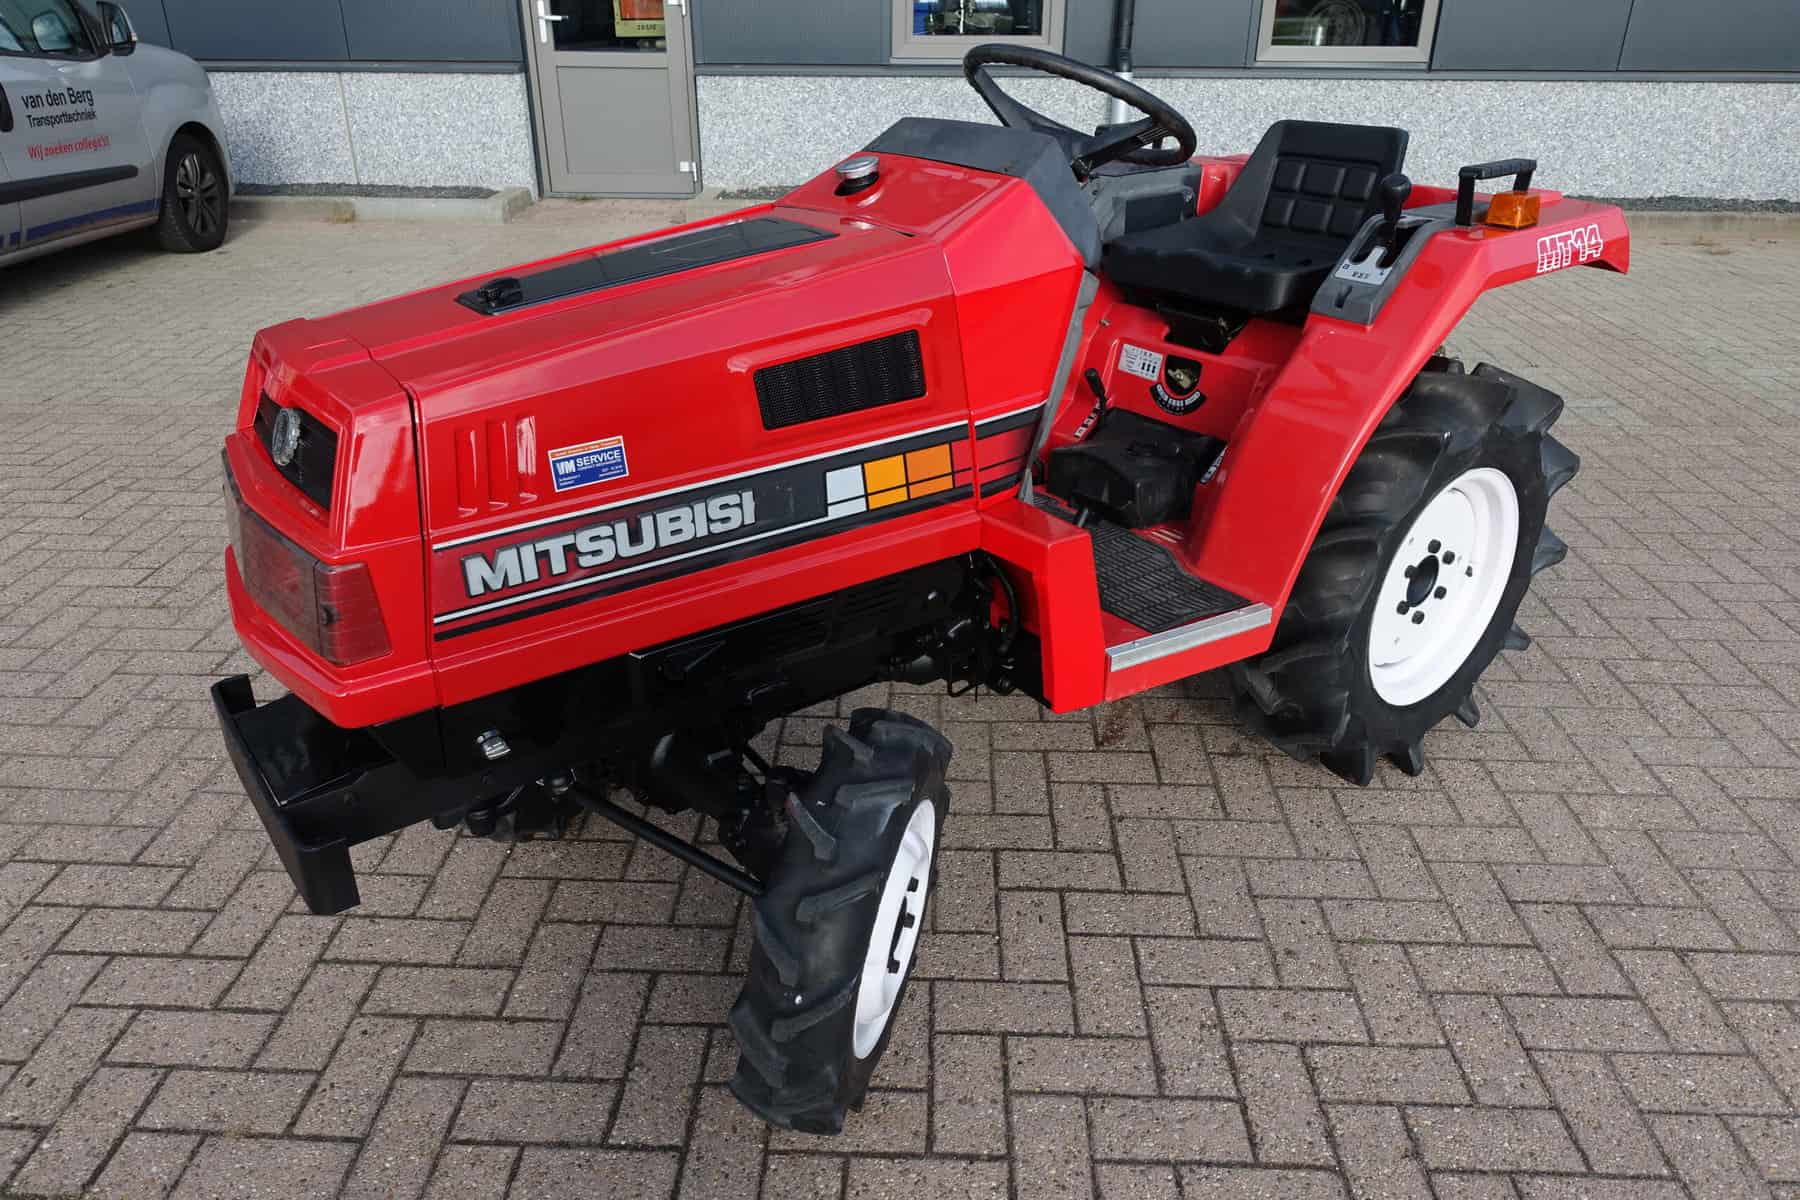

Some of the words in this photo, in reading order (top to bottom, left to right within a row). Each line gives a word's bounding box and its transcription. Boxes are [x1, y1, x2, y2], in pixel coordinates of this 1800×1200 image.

[21, 94, 44, 109] van
[45, 89, 67, 107] den
[66, 87, 94, 106] Berg
[25, 108, 97, 128] Transporttechniek
[1536, 224, 1603, 273] MT14
[575, 449, 622, 467] SERVICE
